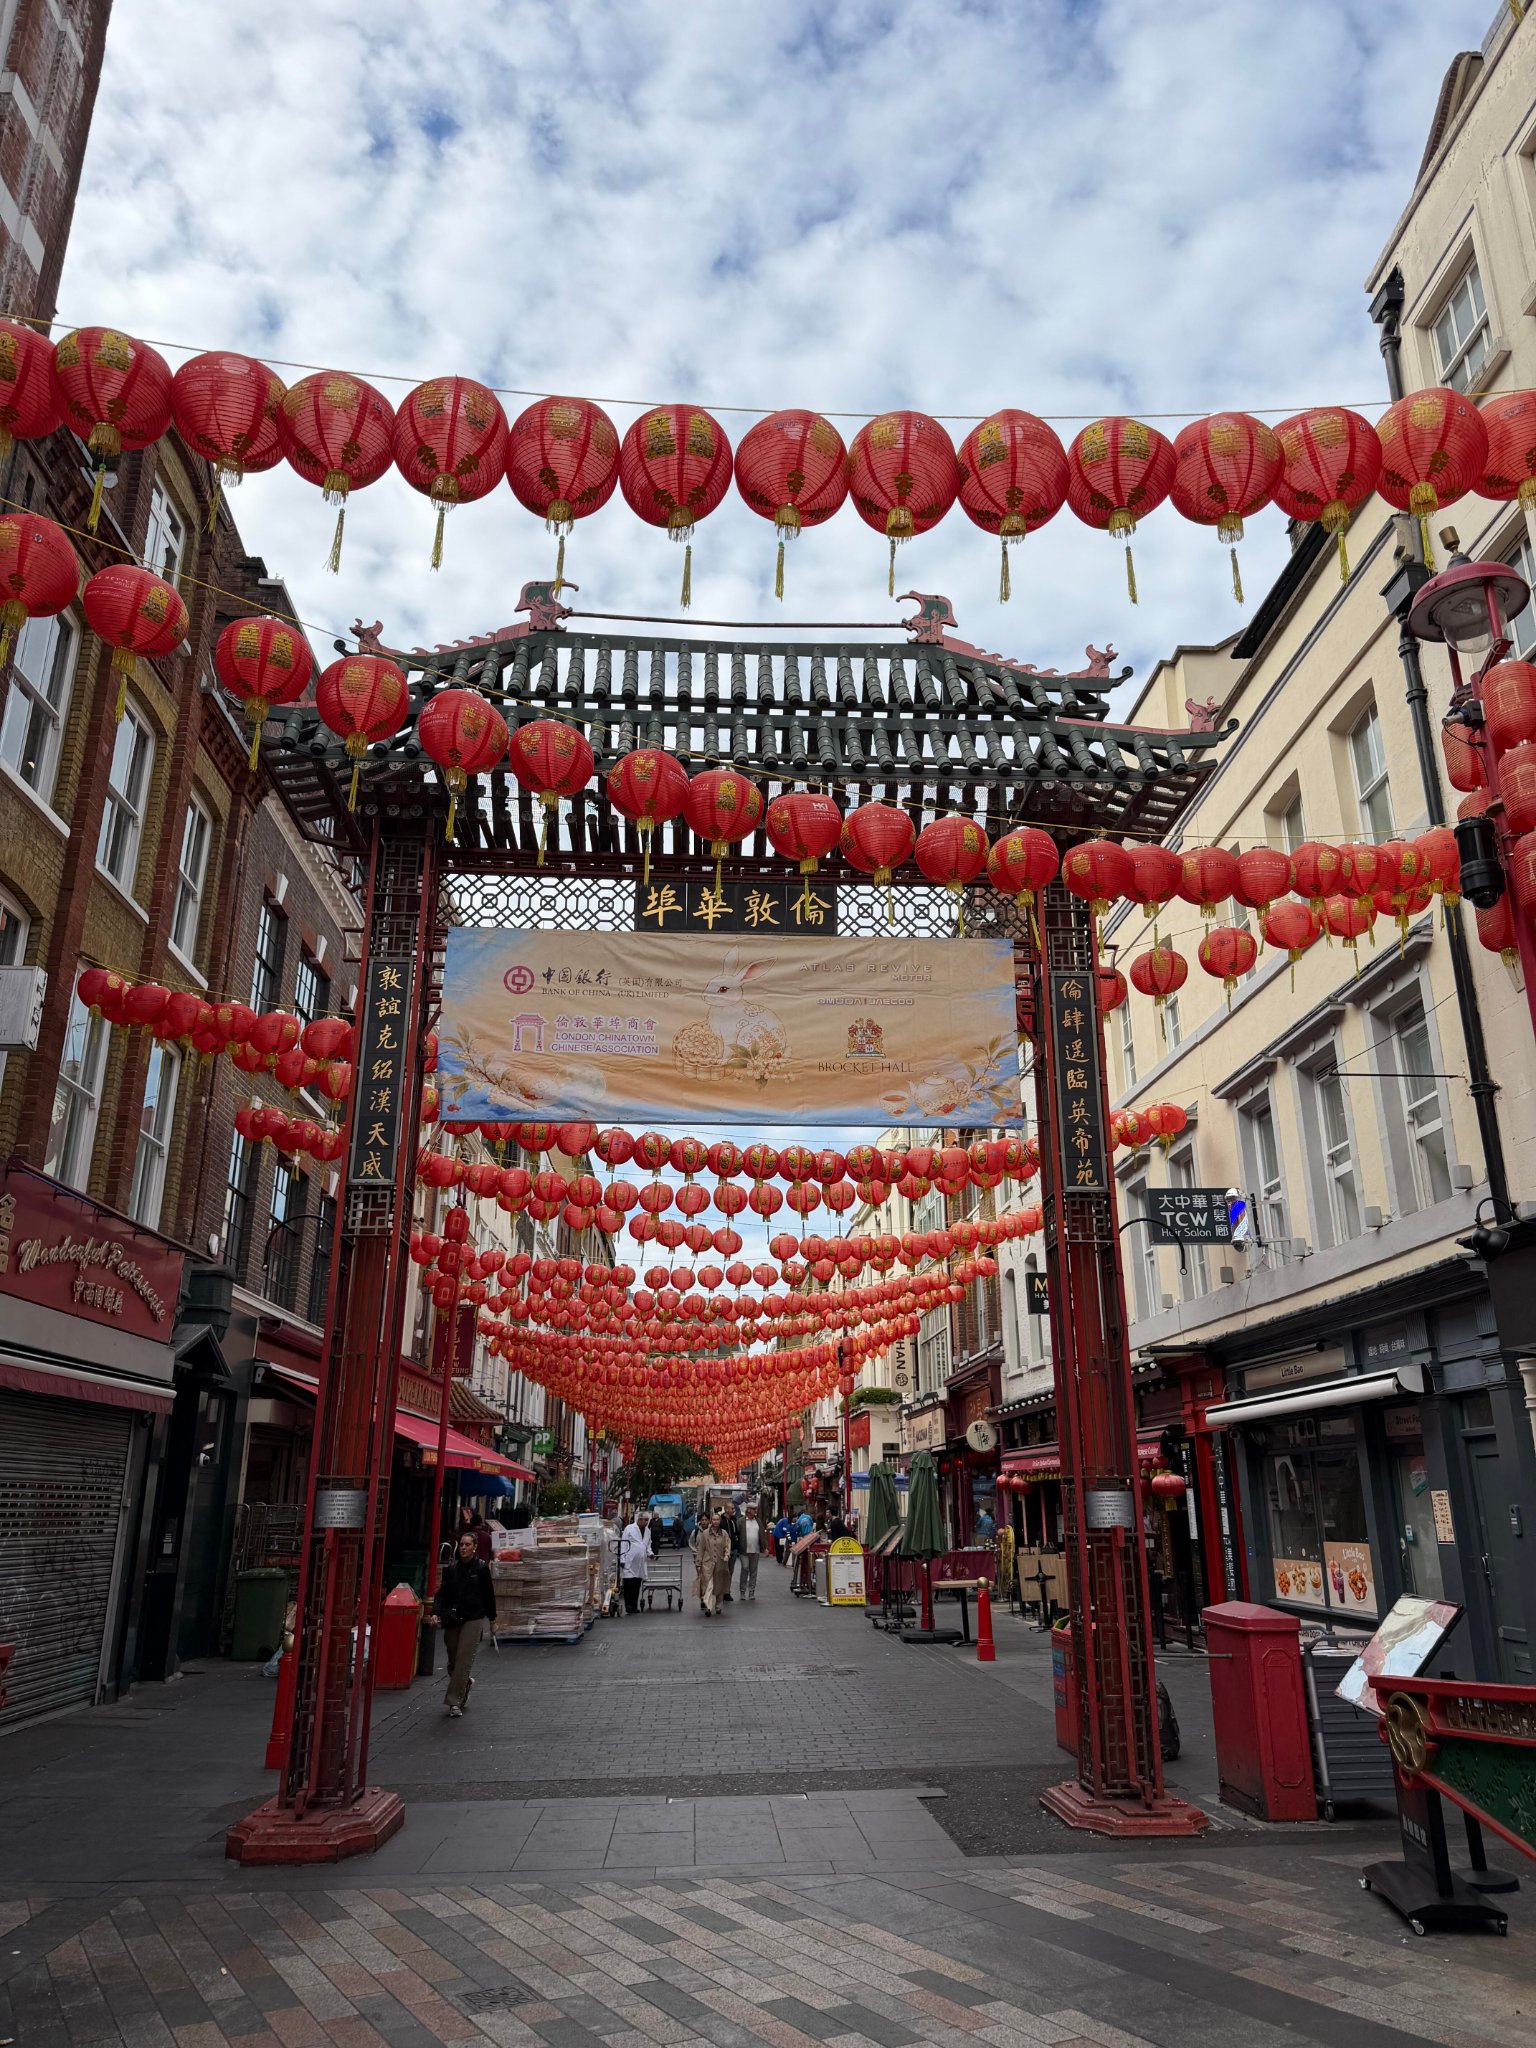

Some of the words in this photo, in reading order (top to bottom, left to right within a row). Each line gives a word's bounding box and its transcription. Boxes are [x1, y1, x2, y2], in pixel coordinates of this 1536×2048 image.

[799, 963, 855, 973] ATLAS
[867, 964, 932, 973] REVIVE
[891, 974, 932, 982] MOTOR
[542, 988, 566, 996] BANK
[568, 988, 580, 996] OF
[582, 989, 611, 997] CHINA
[617, 989, 635, 998] (UK)
[636, 990, 670, 999] LIMITED
[555, 1033, 596, 1041] LONDON
[598, 1034, 655, 1042] CHINATOWN
[551, 1043, 595, 1052] CHINESE
[595, 1045, 659, 1054] ASSOCIATION
[818, 1062, 875, 1074] BROCKET
[881, 1062, 914, 1073] HALL
[1158, 1194, 1208, 1209] 大中華
[1160, 1211, 1208, 1227] TCW
[1211, 1194, 1229, 1237] 美髮廊
[1161, 1228, 1182, 1237] Hair
[1184, 1227, 1212, 1237] Salon
[17, 1235, 110, 1274] Wonderful
[1281, 1367, 1294, 1378] Little
[1294, 1366, 1304, 1376] Bao
[534, 1432, 550, 1445] PP
